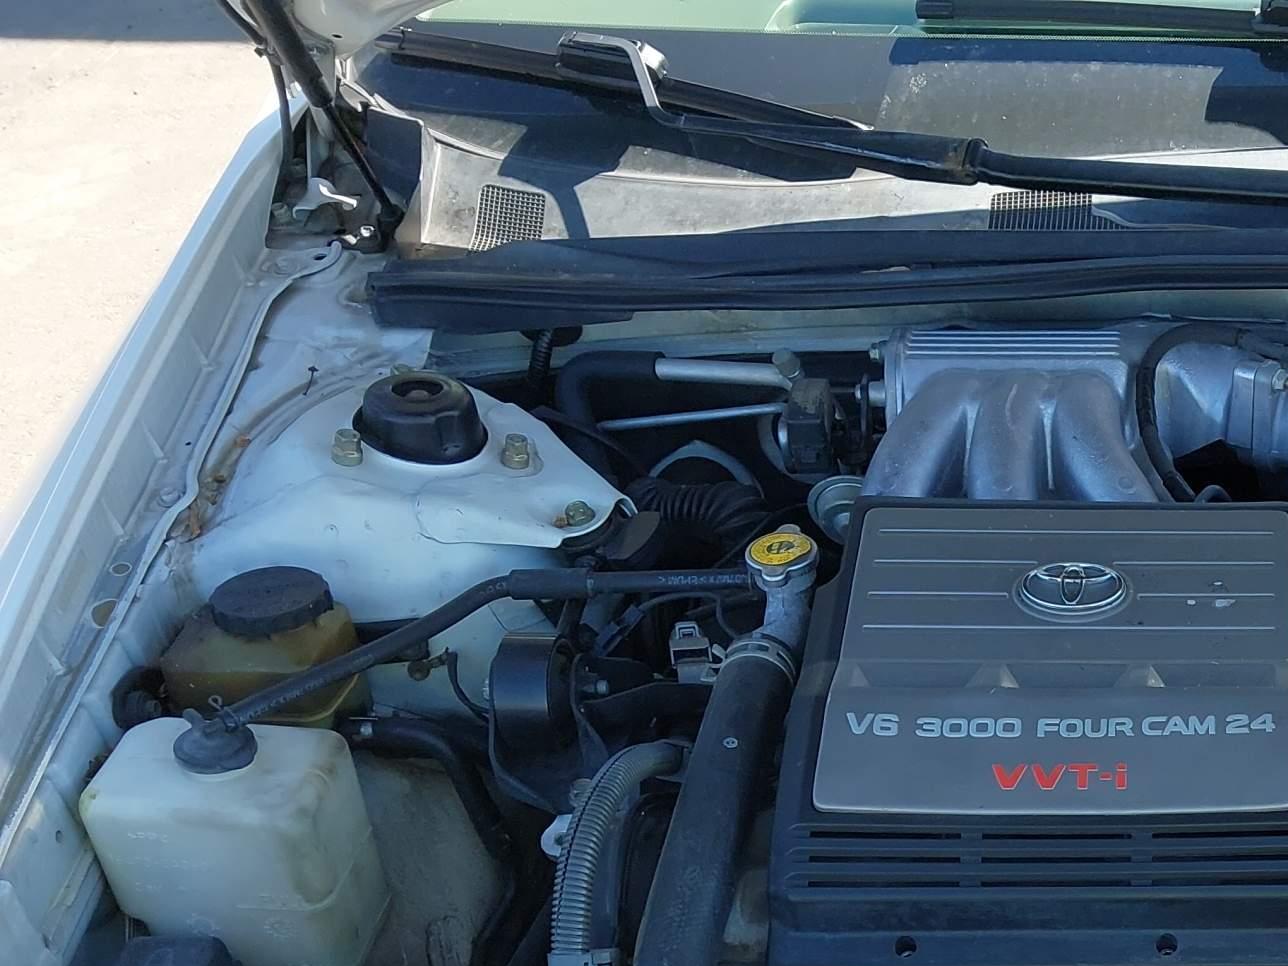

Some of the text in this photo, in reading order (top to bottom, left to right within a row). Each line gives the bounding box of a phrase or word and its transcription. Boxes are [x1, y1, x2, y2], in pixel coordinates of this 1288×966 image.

[846, 712, 1276, 738] V6 3000 FOUR CAM 24
[991, 762, 1129, 790] VVT-i
